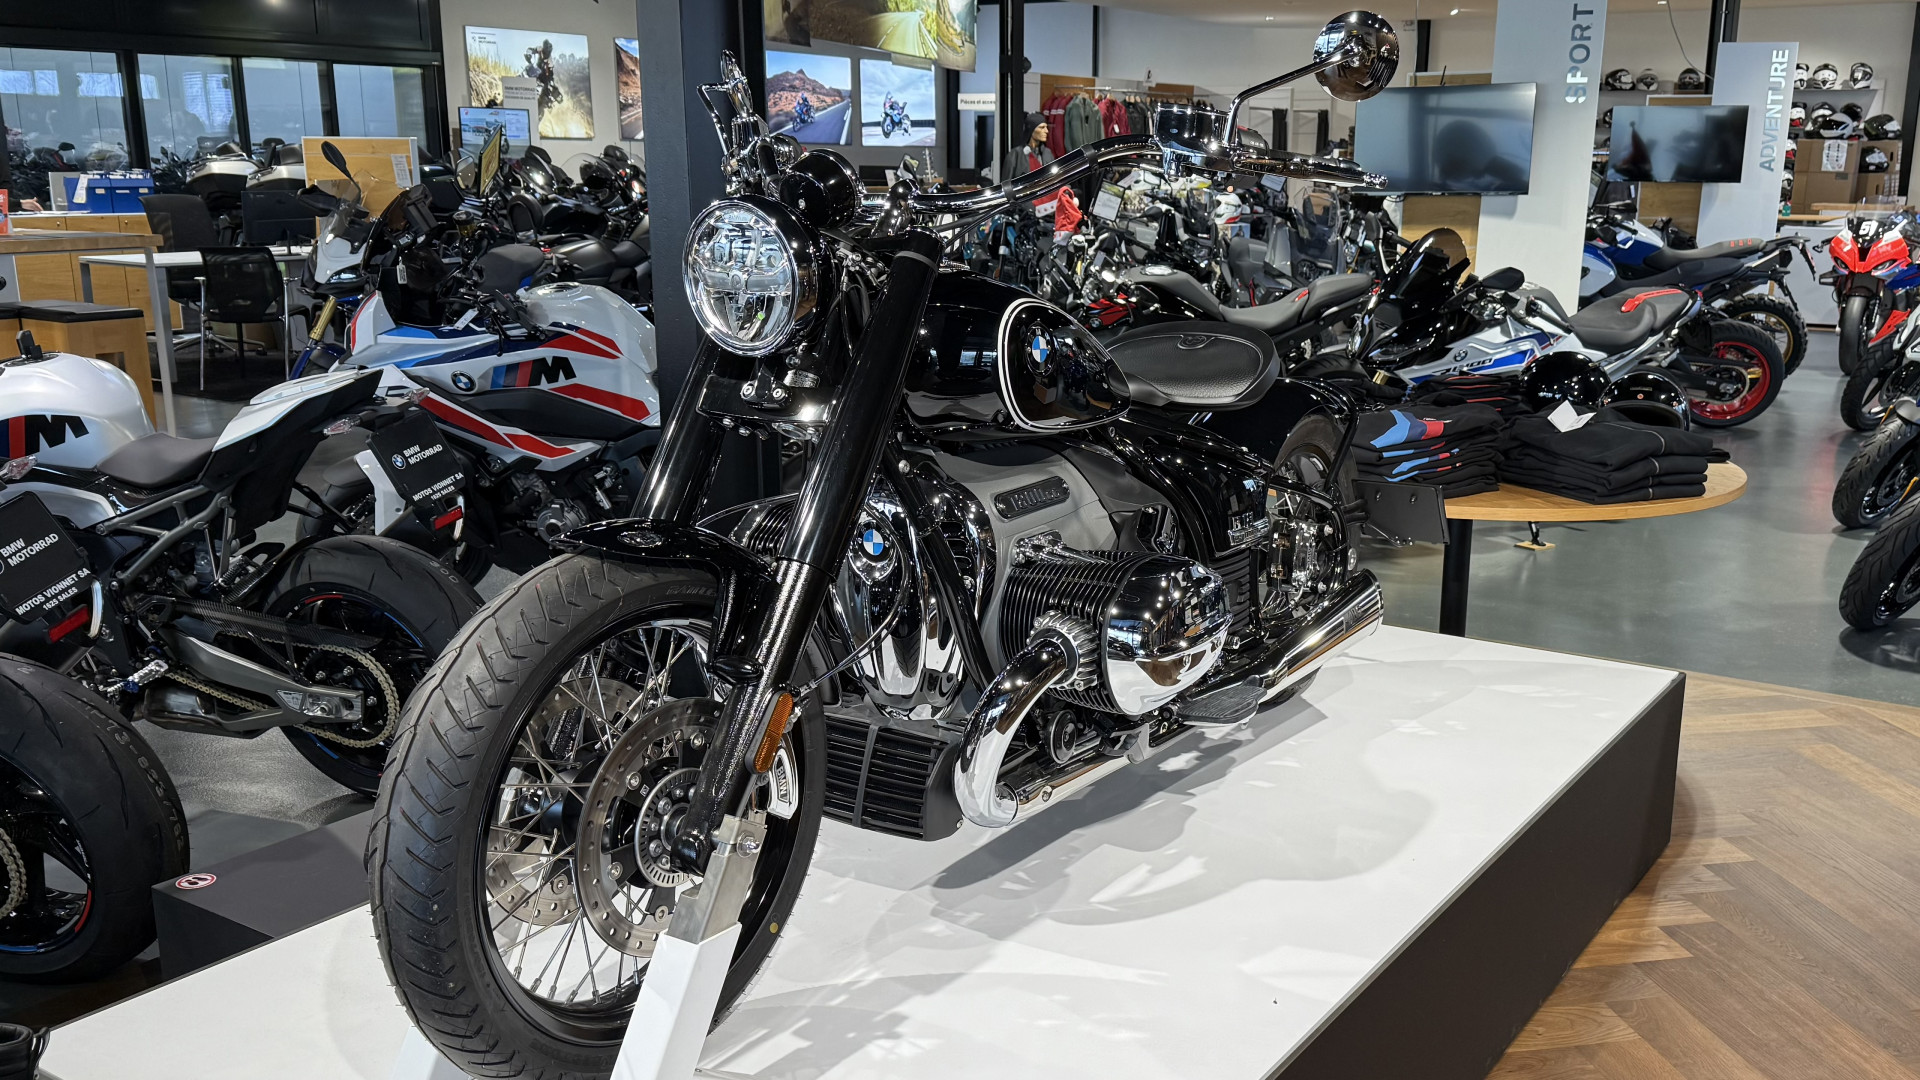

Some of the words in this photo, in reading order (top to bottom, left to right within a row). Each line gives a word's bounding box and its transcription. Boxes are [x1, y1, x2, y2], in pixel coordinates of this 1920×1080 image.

[1565, 3, 1594, 104] SPORT
[1759, 49, 1789, 172] ADVENTURE
[528, 356, 577, 387] M
[24, 414, 90, 457] M
[402, 444, 421, 458] BMW
[407, 443, 443, 466] MOTORRAD
[412, 488, 433, 502] MOTOS
[431, 475, 456, 491] VIONNET
[454, 472, 464, 480] SA
[440, 485, 456, 496] SALES
[0, 537, 26, 558] BMW
[7, 533, 59, 567] MOTORRAD
[15, 594, 46, 616] MOTOS
[43, 573, 80, 598] VIONNET
[77, 567, 92, 578] SA
[42, 598, 59, 611] 1625
[57, 586, 79, 602] SALES
[776, 765, 788, 801] BMW
